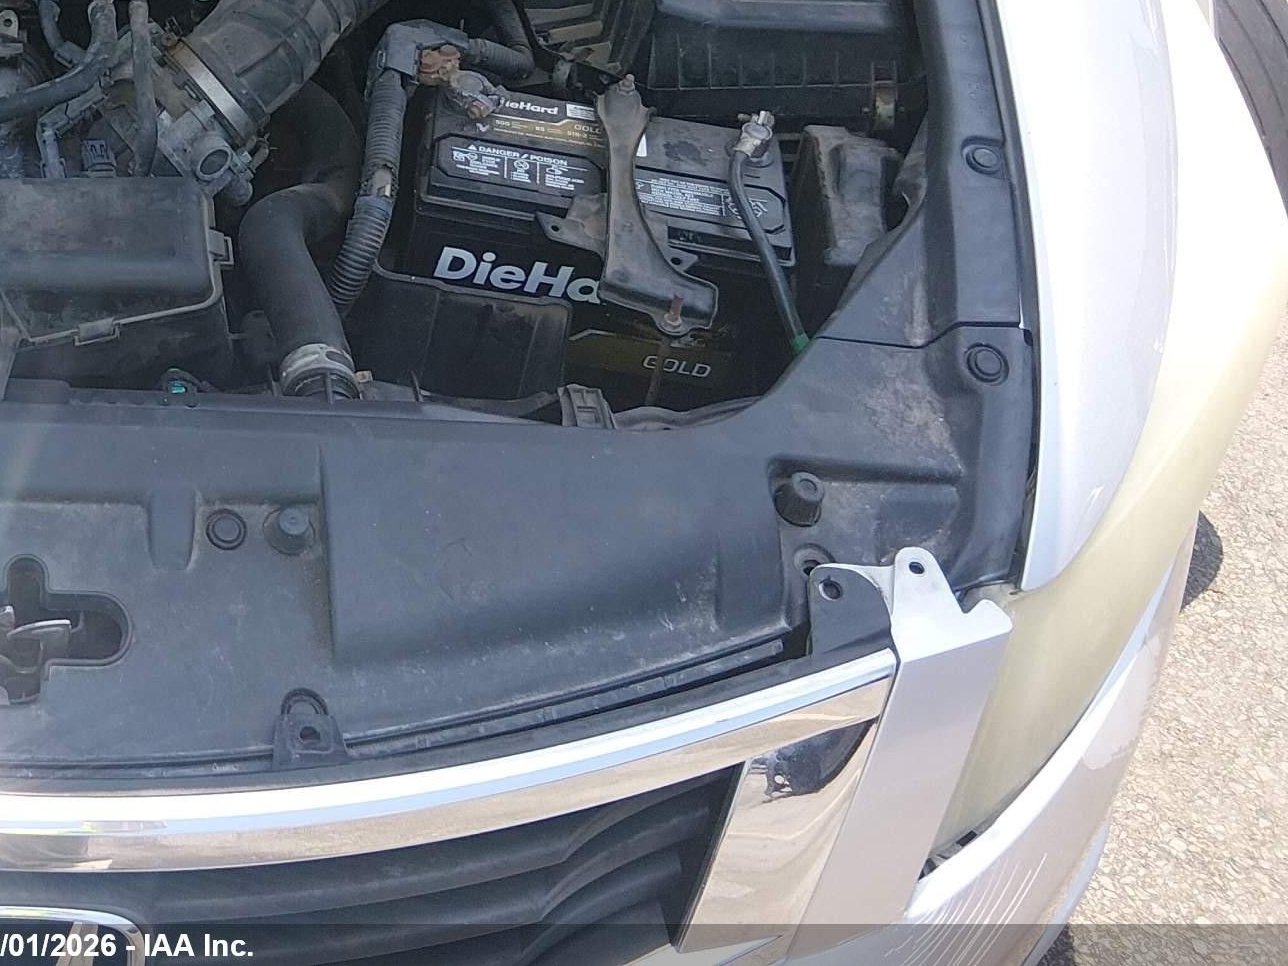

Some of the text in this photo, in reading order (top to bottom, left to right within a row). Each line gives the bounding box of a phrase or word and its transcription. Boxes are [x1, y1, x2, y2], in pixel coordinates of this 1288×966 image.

[500, 98, 559, 115] ieHard
[478, 145, 520, 158] DANGER
[530, 154, 568, 166] POISON
[433, 246, 606, 305] DieHa
[642, 355, 712, 378] GOLD
